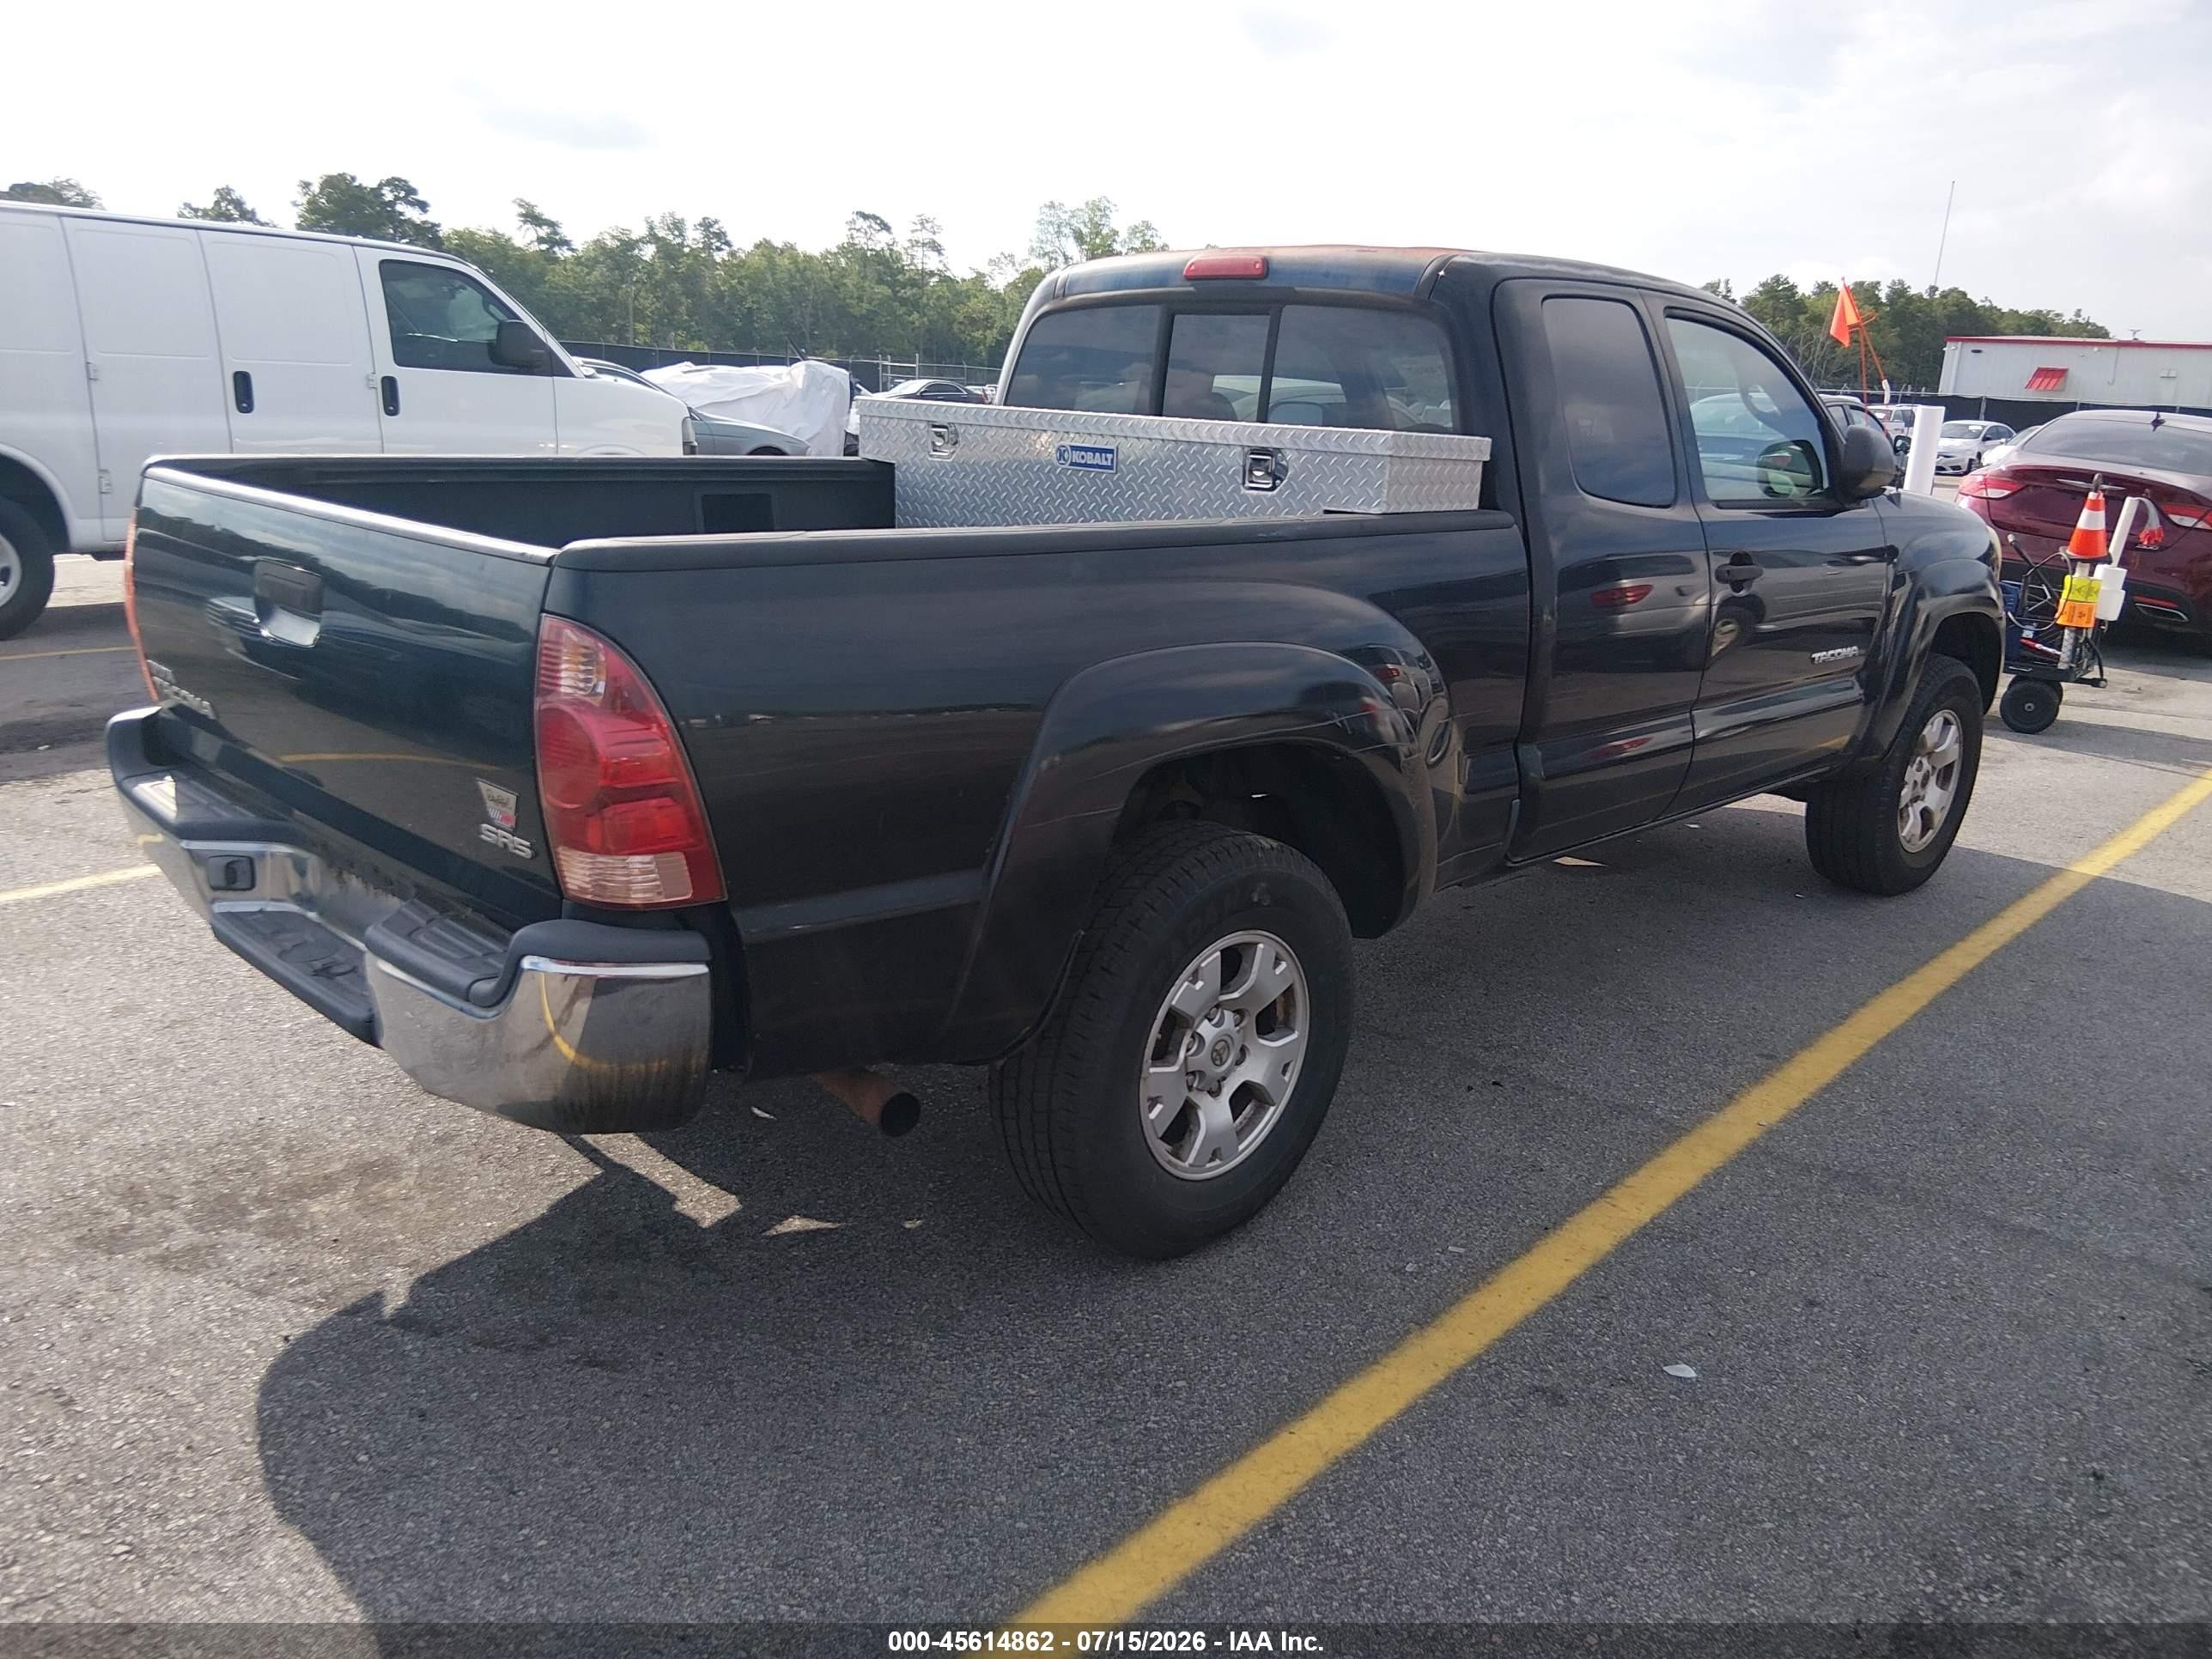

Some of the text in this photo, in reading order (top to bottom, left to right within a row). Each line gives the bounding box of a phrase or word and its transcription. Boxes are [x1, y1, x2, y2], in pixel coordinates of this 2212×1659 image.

[1072, 449, 1114, 466] KOBALT
[1811, 646, 1858, 665] TACOMA
[480, 823, 532, 860] SR5
